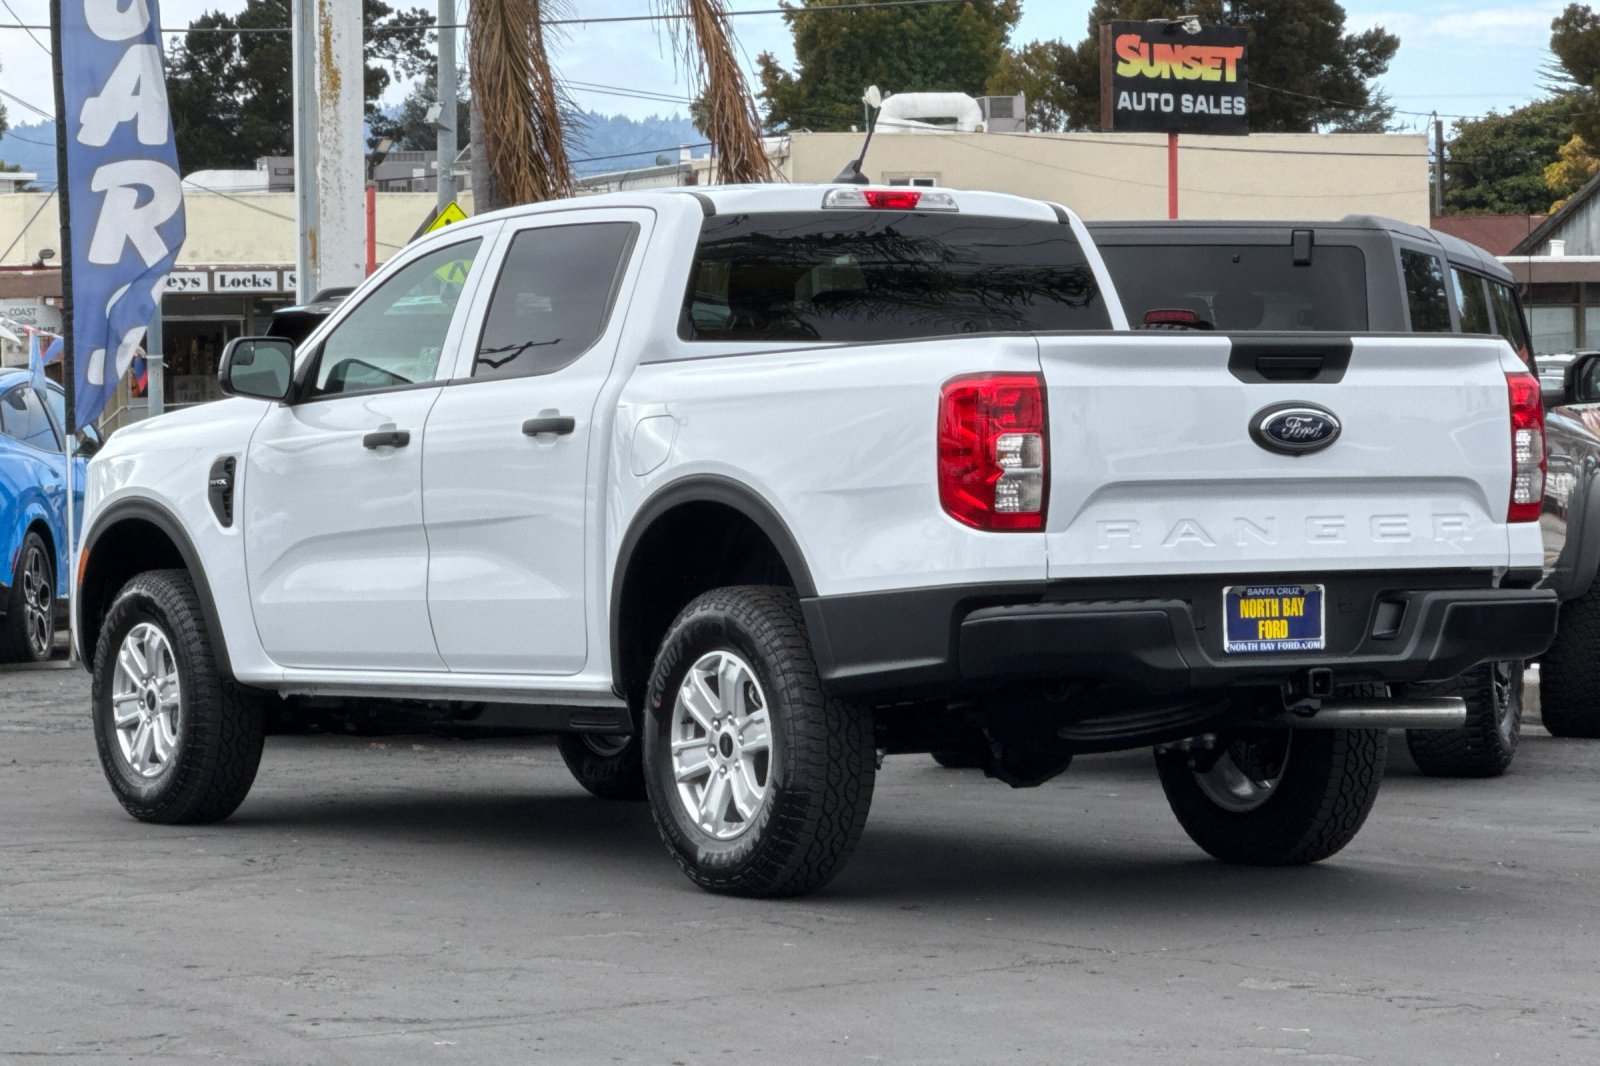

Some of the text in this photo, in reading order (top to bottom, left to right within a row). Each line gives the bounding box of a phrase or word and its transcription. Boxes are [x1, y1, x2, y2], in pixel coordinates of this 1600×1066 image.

[1115, 33, 1244, 83] SUNSET
[1117, 91, 1246, 116] AUTO SALES
[163, 276, 201, 291] eys
[219, 274, 272, 288] Locks
[9, 307, 37, 317] COAST
[1282, 416, 1324, 438] Ford
[1096, 512, 1475, 551] RANGER
[1247, 587, 1300, 596] SANTA CRUZ
[1240, 597, 1305, 619] NORTH BAY
[1257, 619, 1289, 640] FORD
[1229, 640, 1321, 652] NORTH BAY FORD.COM
